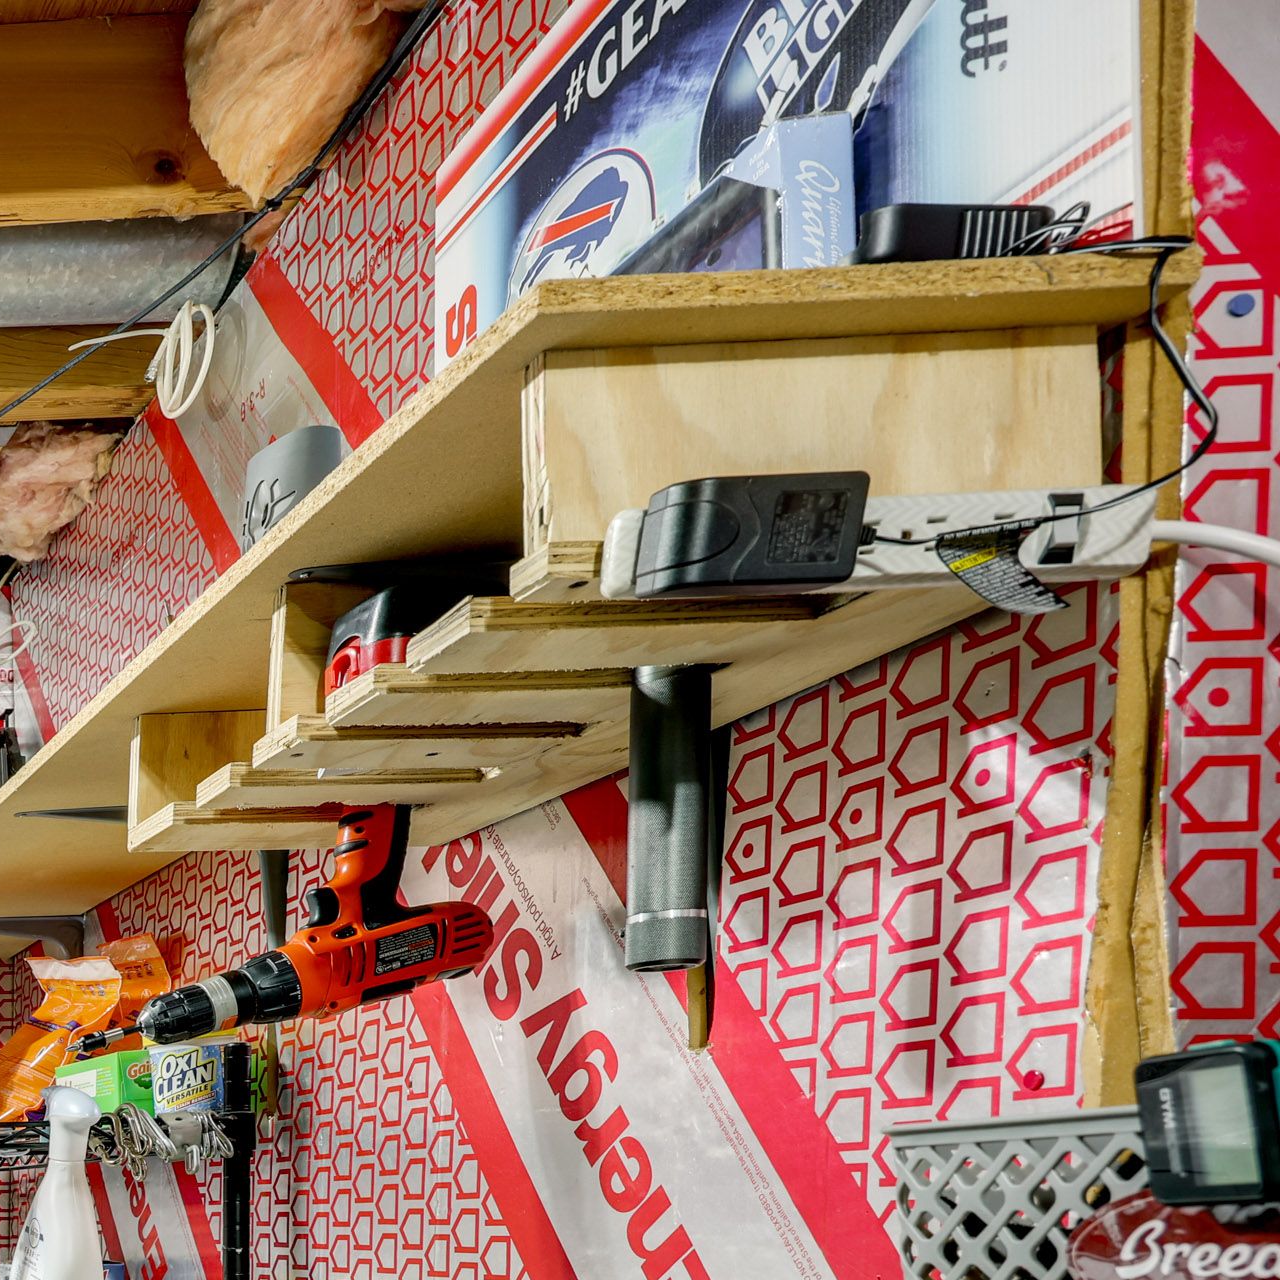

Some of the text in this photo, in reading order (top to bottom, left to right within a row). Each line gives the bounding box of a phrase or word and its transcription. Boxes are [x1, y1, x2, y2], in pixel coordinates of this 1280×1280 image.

[958, 531, 971, 541] NOT
[971, 526, 1001, 538] REMOVE
[1001, 523, 1019, 533] THIS
[486, 830, 563, 960] A rigid polyisocyanurate
[653, 1006, 670, 1027] other
[667, 1031, 684, 1053] board
[160, 1049, 200, 1074] OXI
[155, 1061, 215, 1103] CLEAN
[685, 1063, 707, 1094] gypsum
[165, 1083, 210, 1107] VERSATILE
[705, 1081, 737, 1129] specification
[706, 1101, 726, 1128] behind
[719, 1124, 743, 1159] installed
[741, 1164, 758, 1186] must
[744, 1151, 771, 1191] Conforms
[755, 1190, 784, 1232] EXPOSED.
[776, 1229, 798, 1258] LEAVE
[790, 1233, 809, 1258] State
[791, 1256, 807, 1276] NOT
[803, 1256, 817, 1273] the
